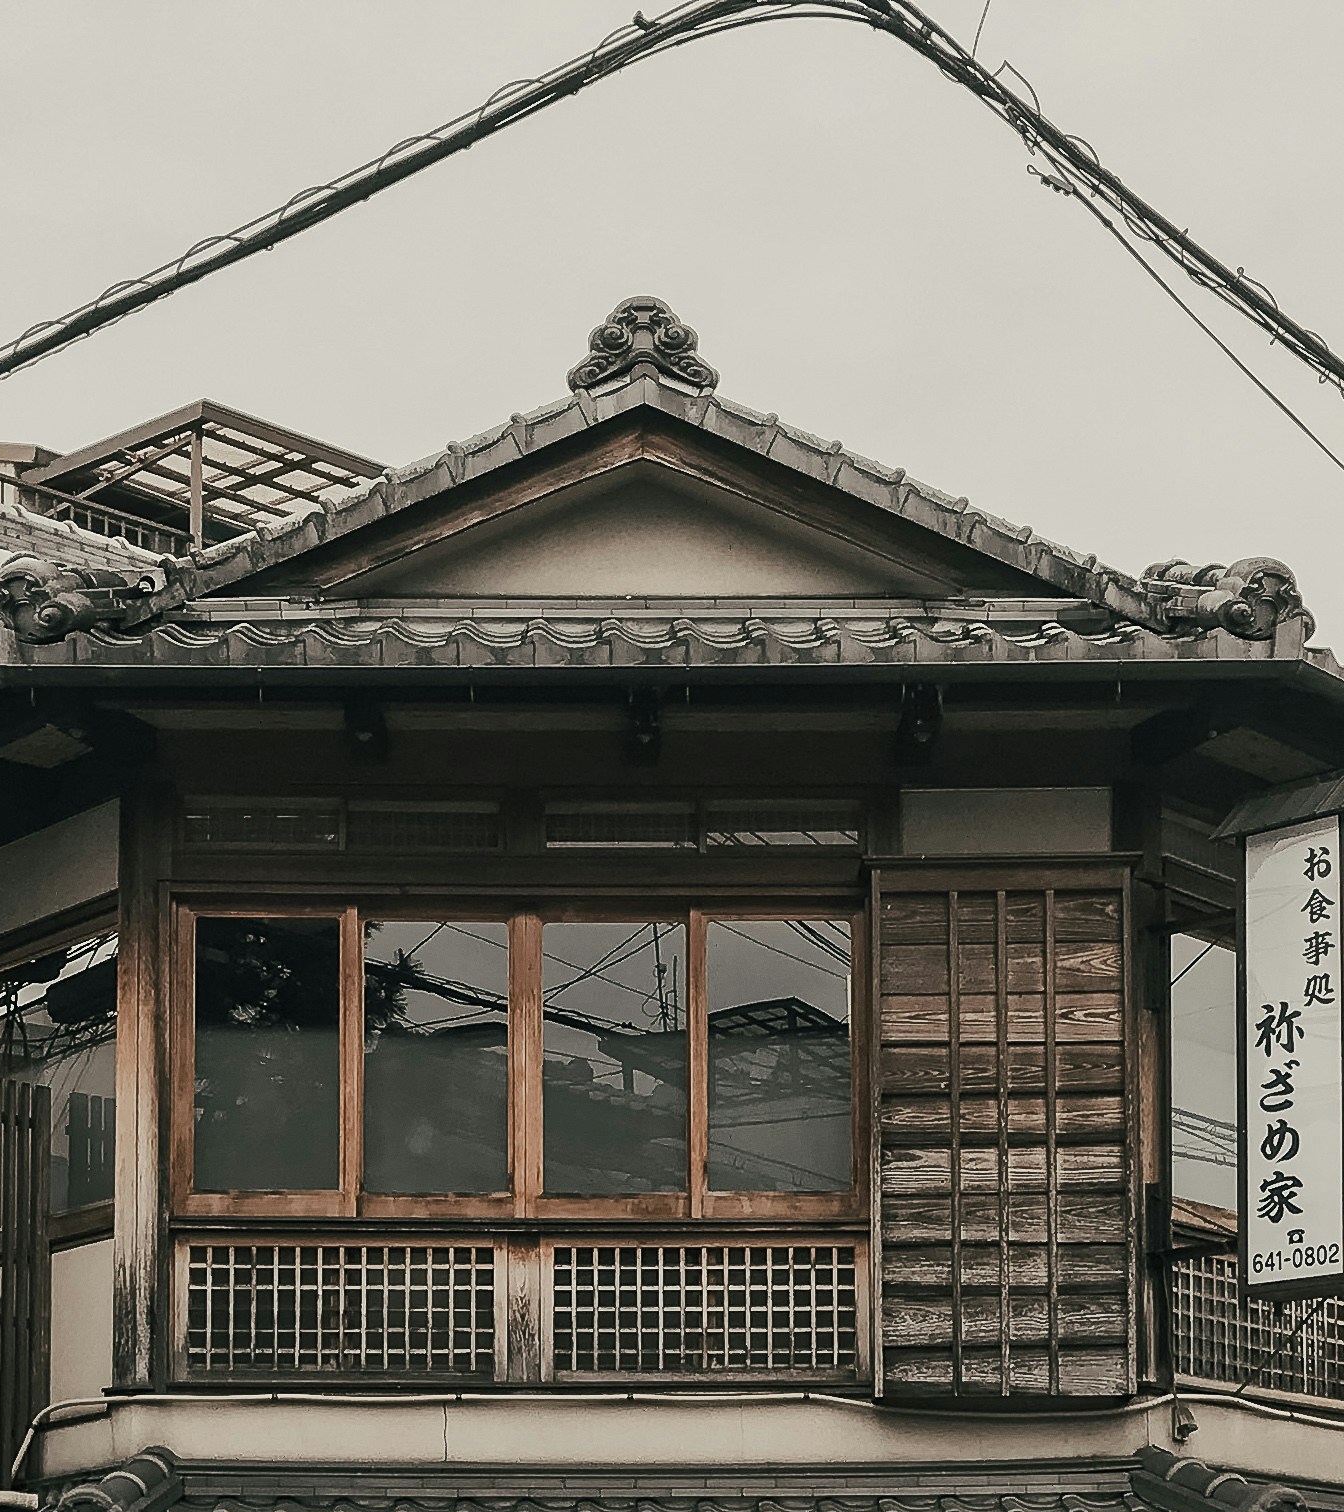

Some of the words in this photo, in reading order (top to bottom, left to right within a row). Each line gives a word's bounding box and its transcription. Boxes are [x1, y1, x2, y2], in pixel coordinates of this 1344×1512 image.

[1300, 846, 1336, 1007] お食事処
[1254, 1001, 1305, 1224] 祢ざめ家
[1252, 1243, 1340, 1274] 641-0802
